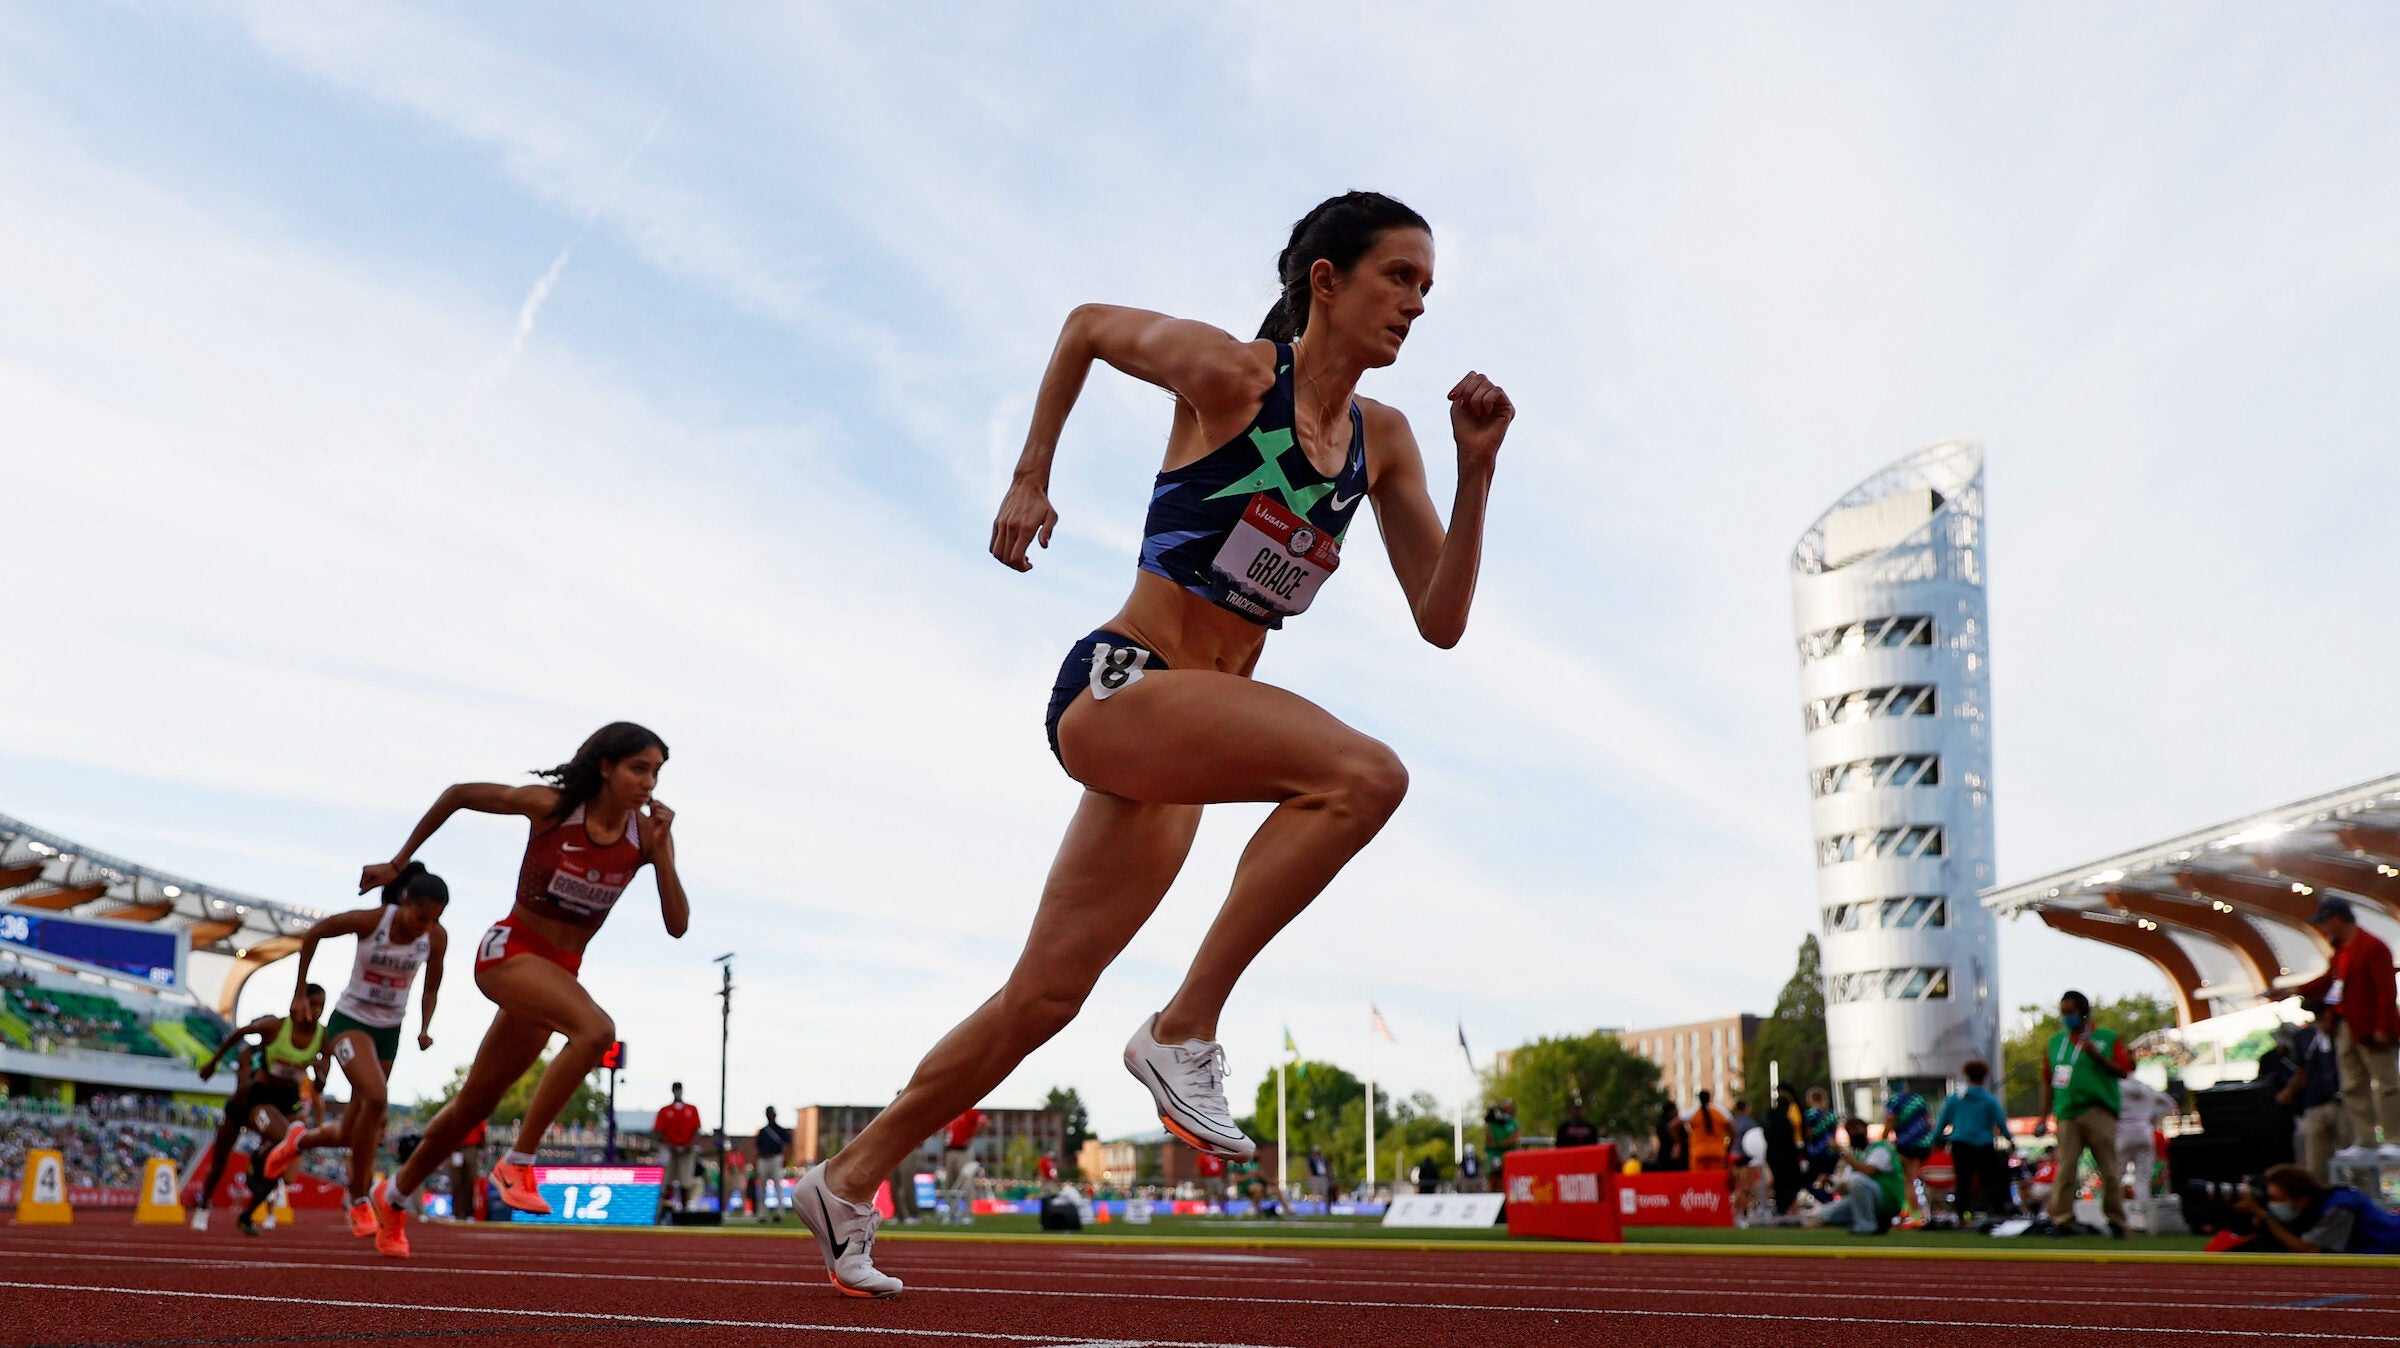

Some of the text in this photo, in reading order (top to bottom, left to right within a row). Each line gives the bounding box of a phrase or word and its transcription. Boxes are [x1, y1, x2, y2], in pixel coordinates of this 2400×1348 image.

[1263, 513, 1289, 531] USATF
[1246, 547, 1309, 600] GRACE
[1101, 647, 1137, 689] 8
[486, 928, 505, 957] 7
[40, 1166, 56, 1190] 4
[156, 1172, 171, 1195] 3
[562, 1186, 612, 1219] 1.2
[1680, 1188, 1720, 1212] xfinity
